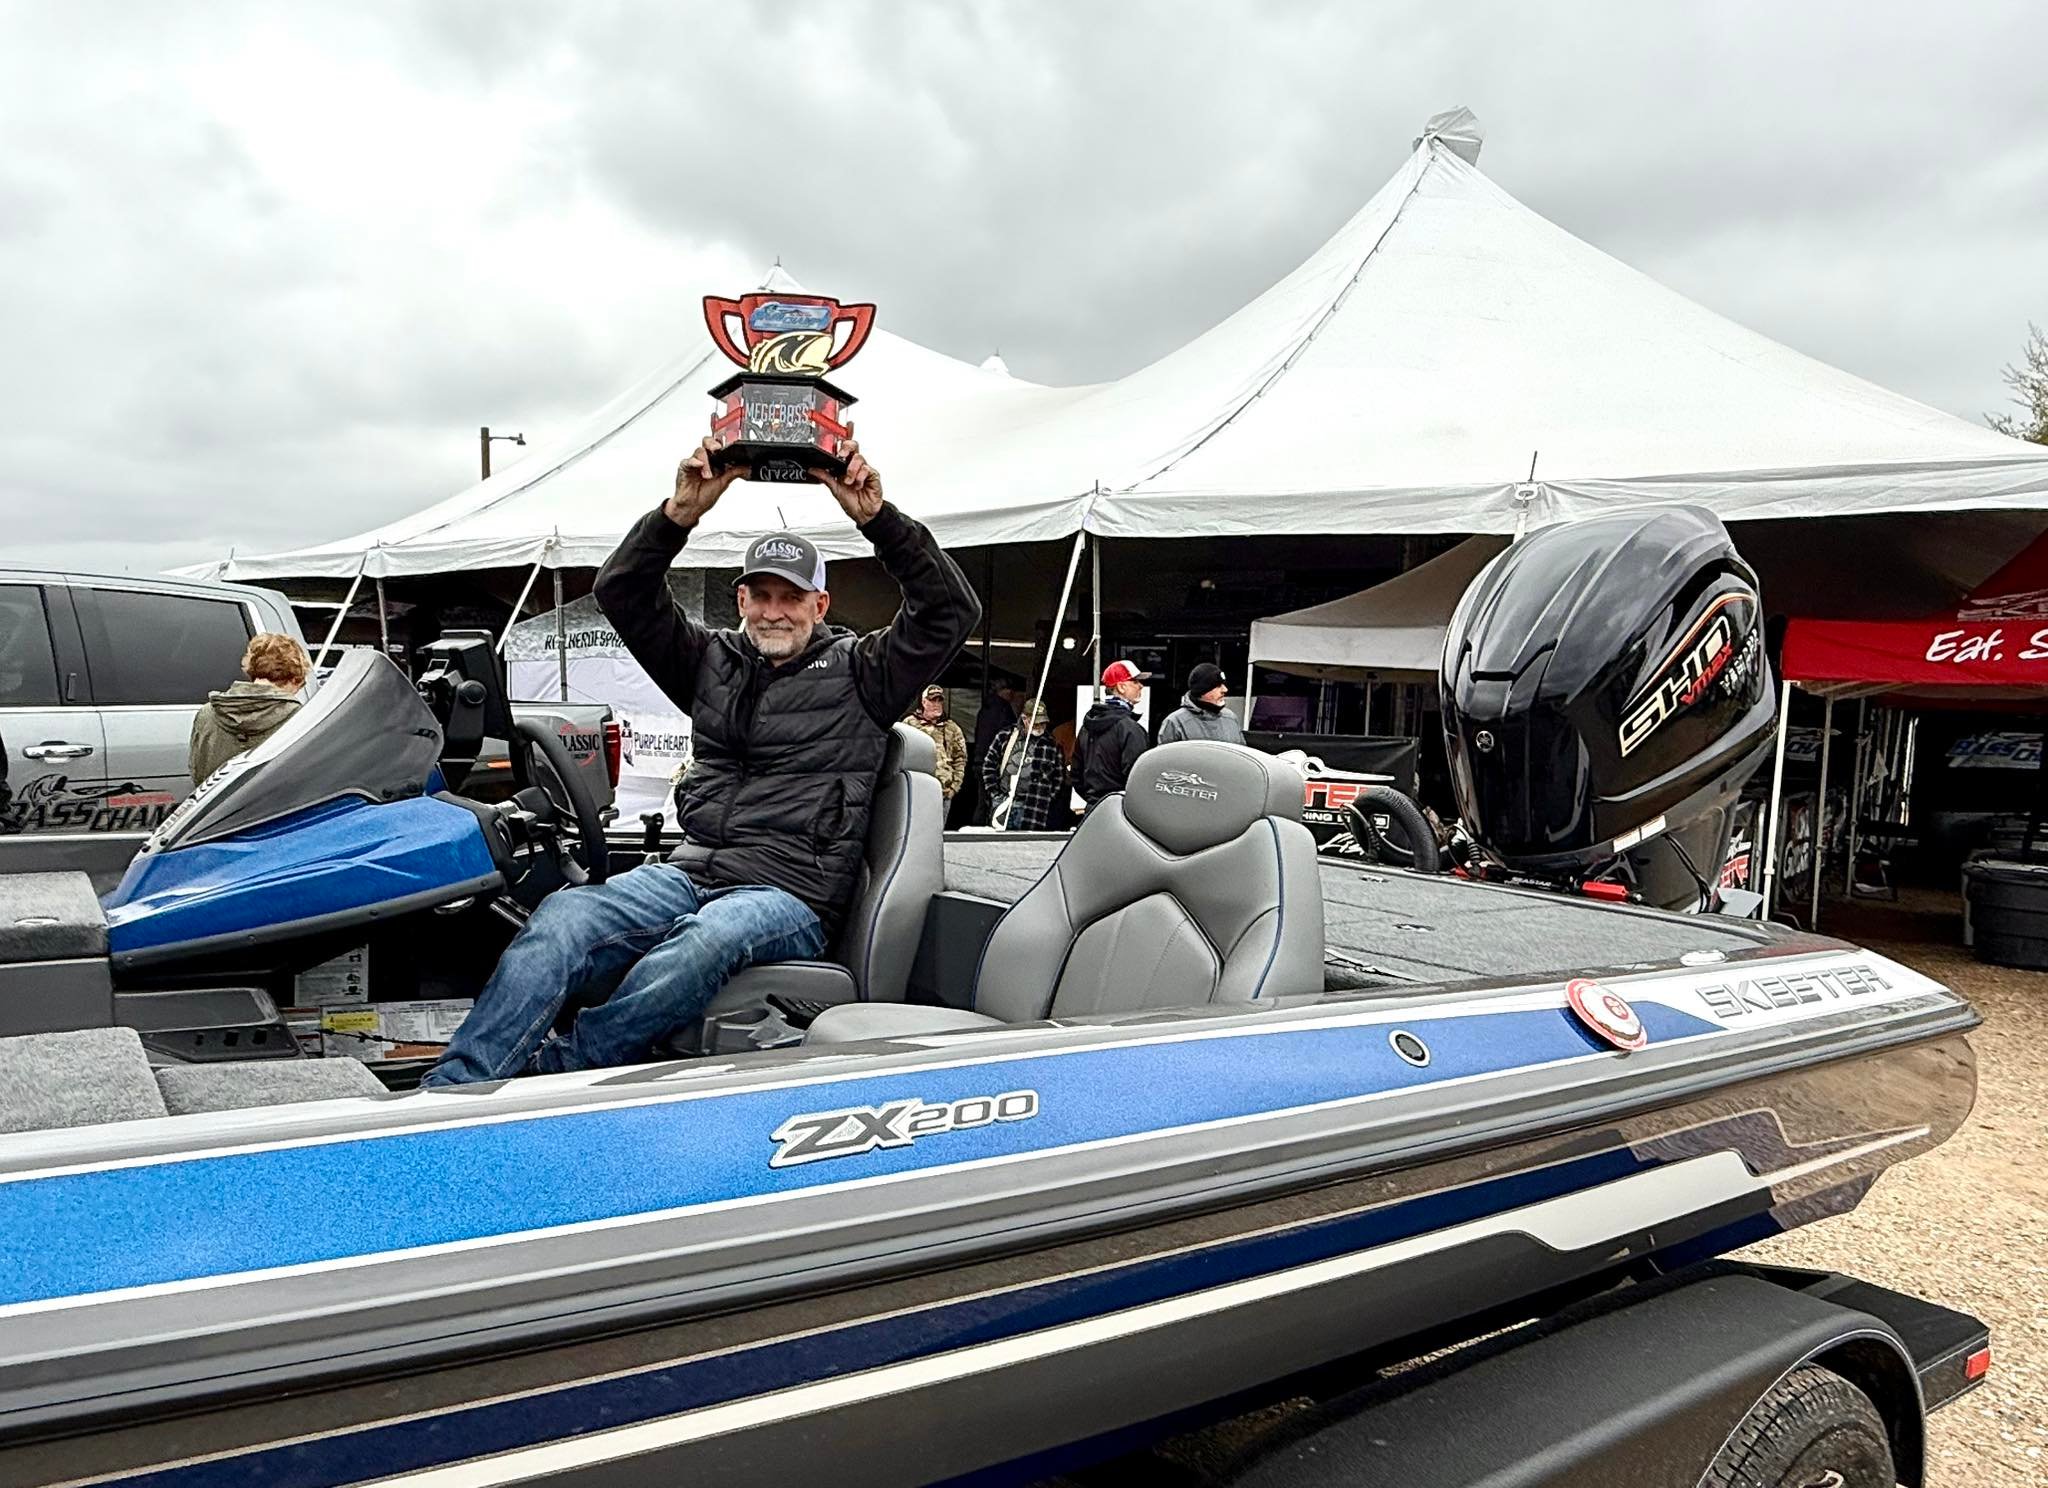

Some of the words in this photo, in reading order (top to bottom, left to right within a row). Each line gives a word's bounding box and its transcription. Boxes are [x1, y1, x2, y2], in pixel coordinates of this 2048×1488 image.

[755, 542, 804, 559] CLASSIC
[1926, 629, 2004, 664] Eat.
[1619, 616, 1731, 757] SHO
[634, 732, 662, 750] PURPLE
[663, 733, 690, 751] HEART
[1155, 783, 1219, 801] SKEETER
[1696, 964, 1893, 1018] SKEETER
[773, 1090, 1038, 1165] ZX200
